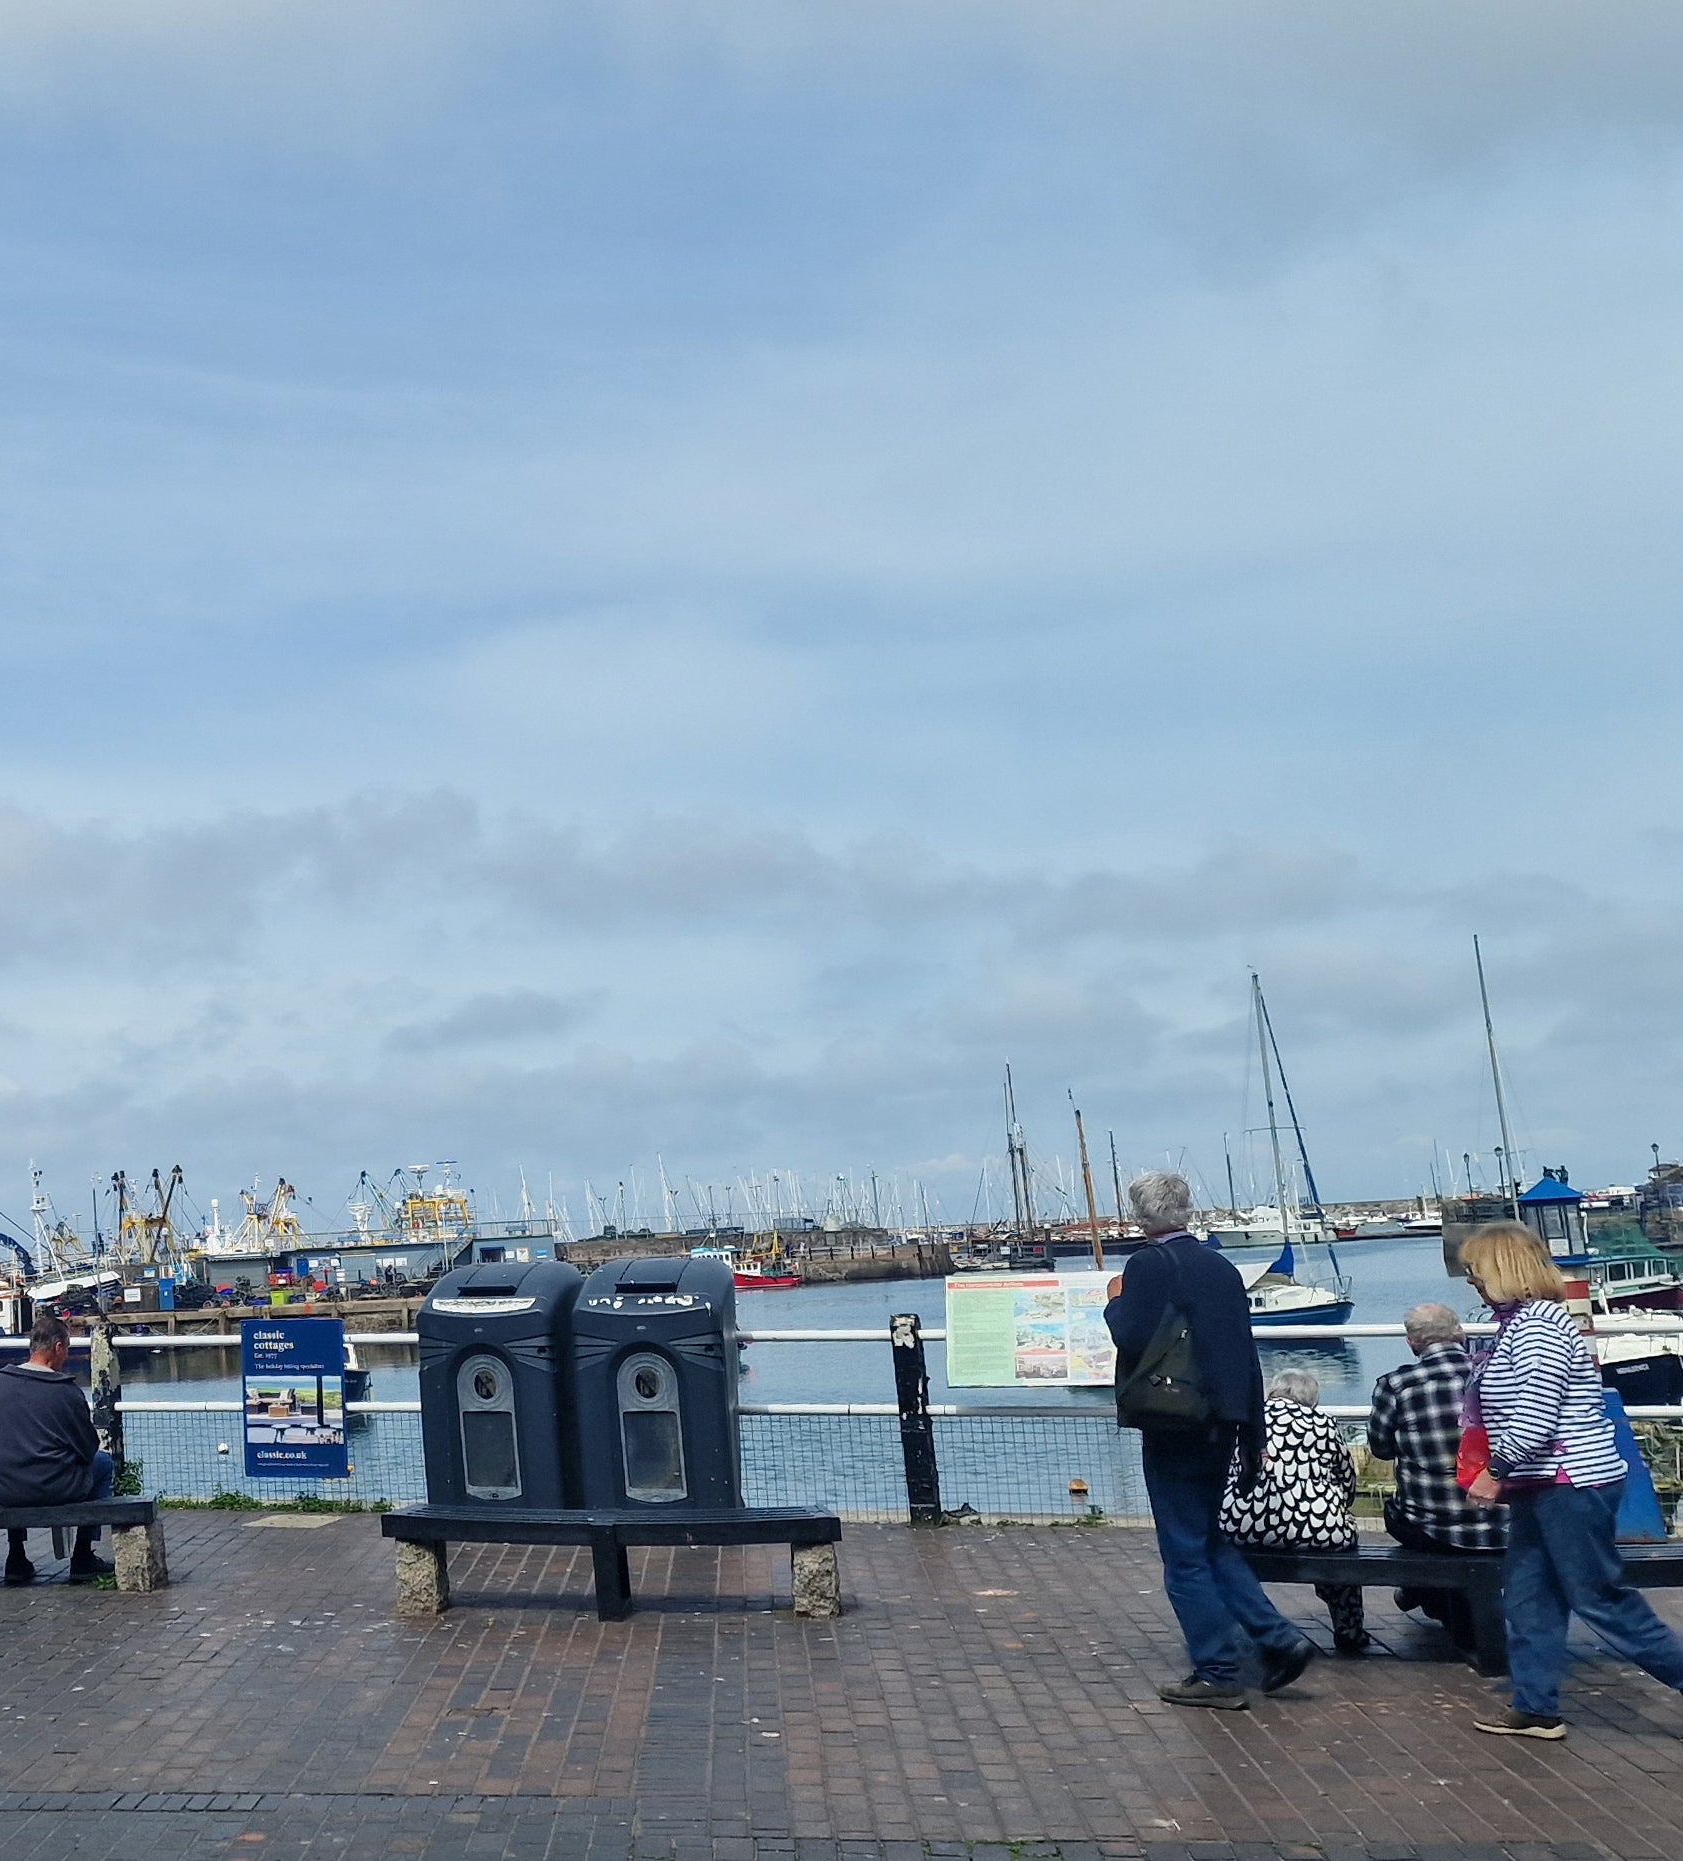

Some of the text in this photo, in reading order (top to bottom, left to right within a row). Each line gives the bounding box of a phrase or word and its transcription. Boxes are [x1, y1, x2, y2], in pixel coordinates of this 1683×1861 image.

[253, 1330, 285, 1339] classic
[253, 1342, 294, 1352] cottages
[257, 1450, 307, 1459] classic.co.uk
